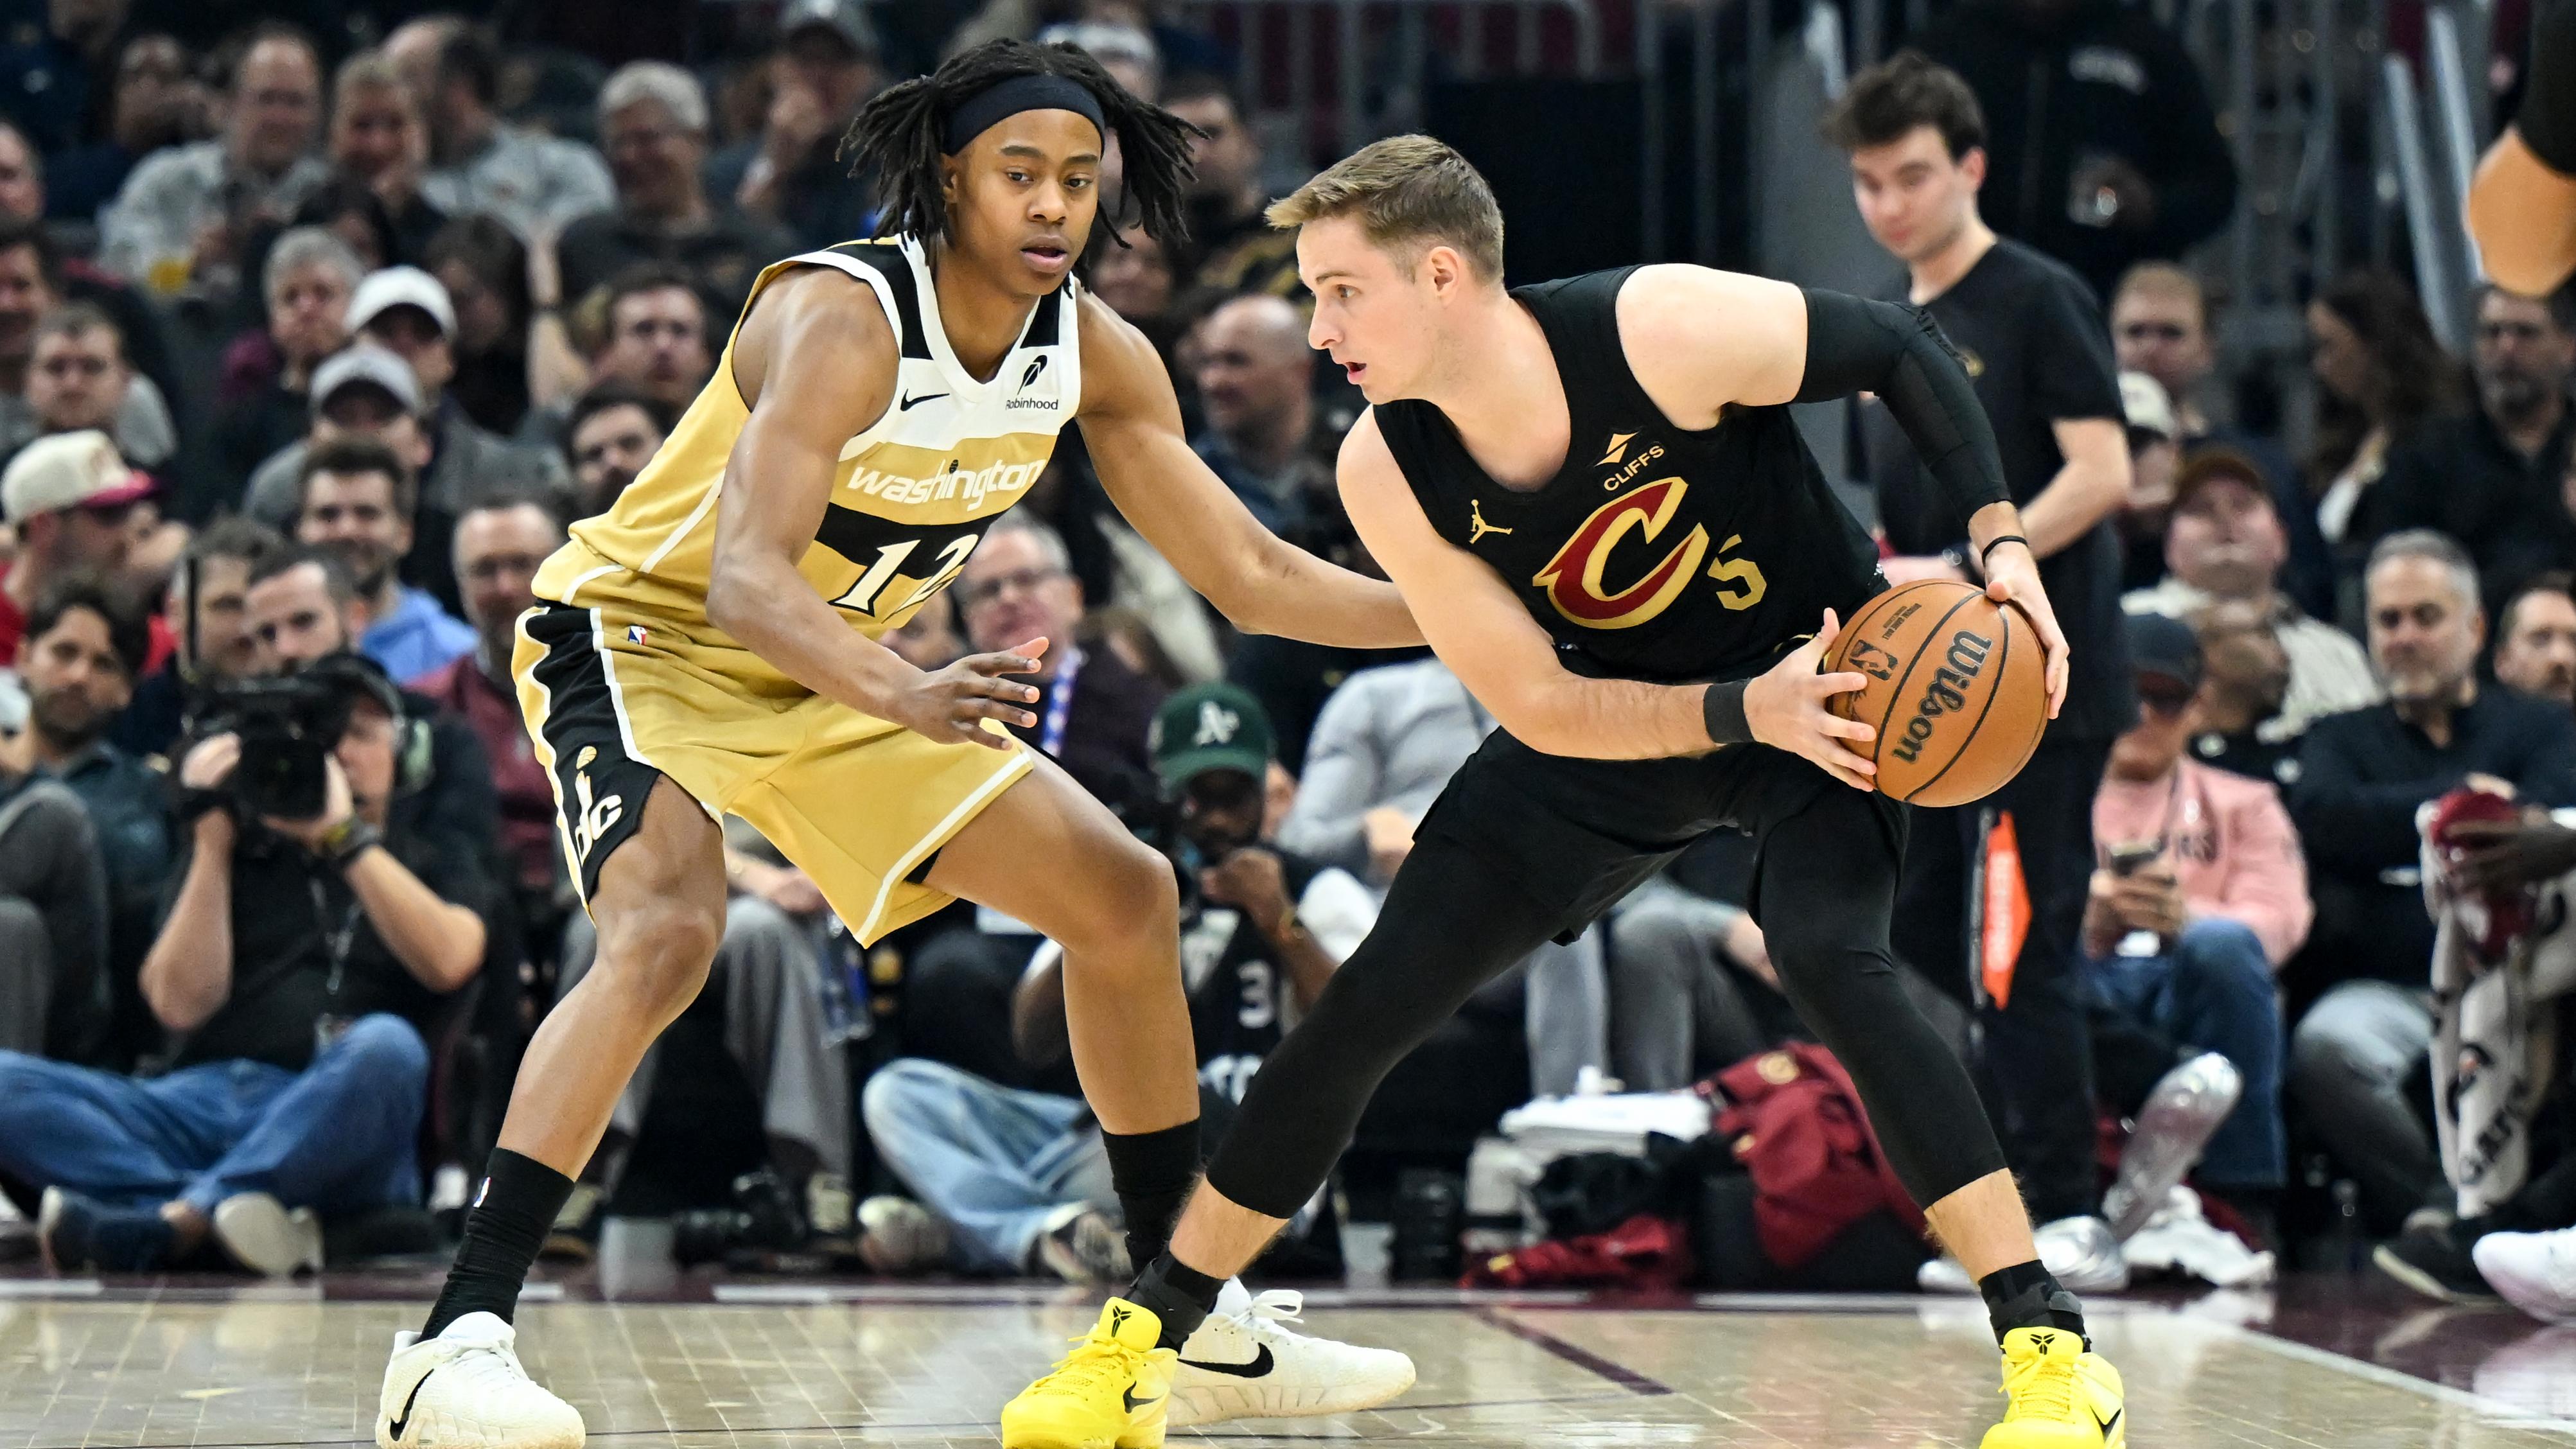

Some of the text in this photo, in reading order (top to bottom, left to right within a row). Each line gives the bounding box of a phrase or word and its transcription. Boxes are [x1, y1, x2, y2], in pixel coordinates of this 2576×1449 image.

[1005, 397, 1058, 410] Robinhood
[847, 459, 1047, 512] washington
[1604, 445, 1665, 491] CLIFFS
[828, 533, 979, 624] 12
[1532, 477, 1710, 629] C
[1707, 534, 1767, 610] 5
[1891, 629, 1992, 764] Wilson
[1237, 959, 1275, 1029] 3
